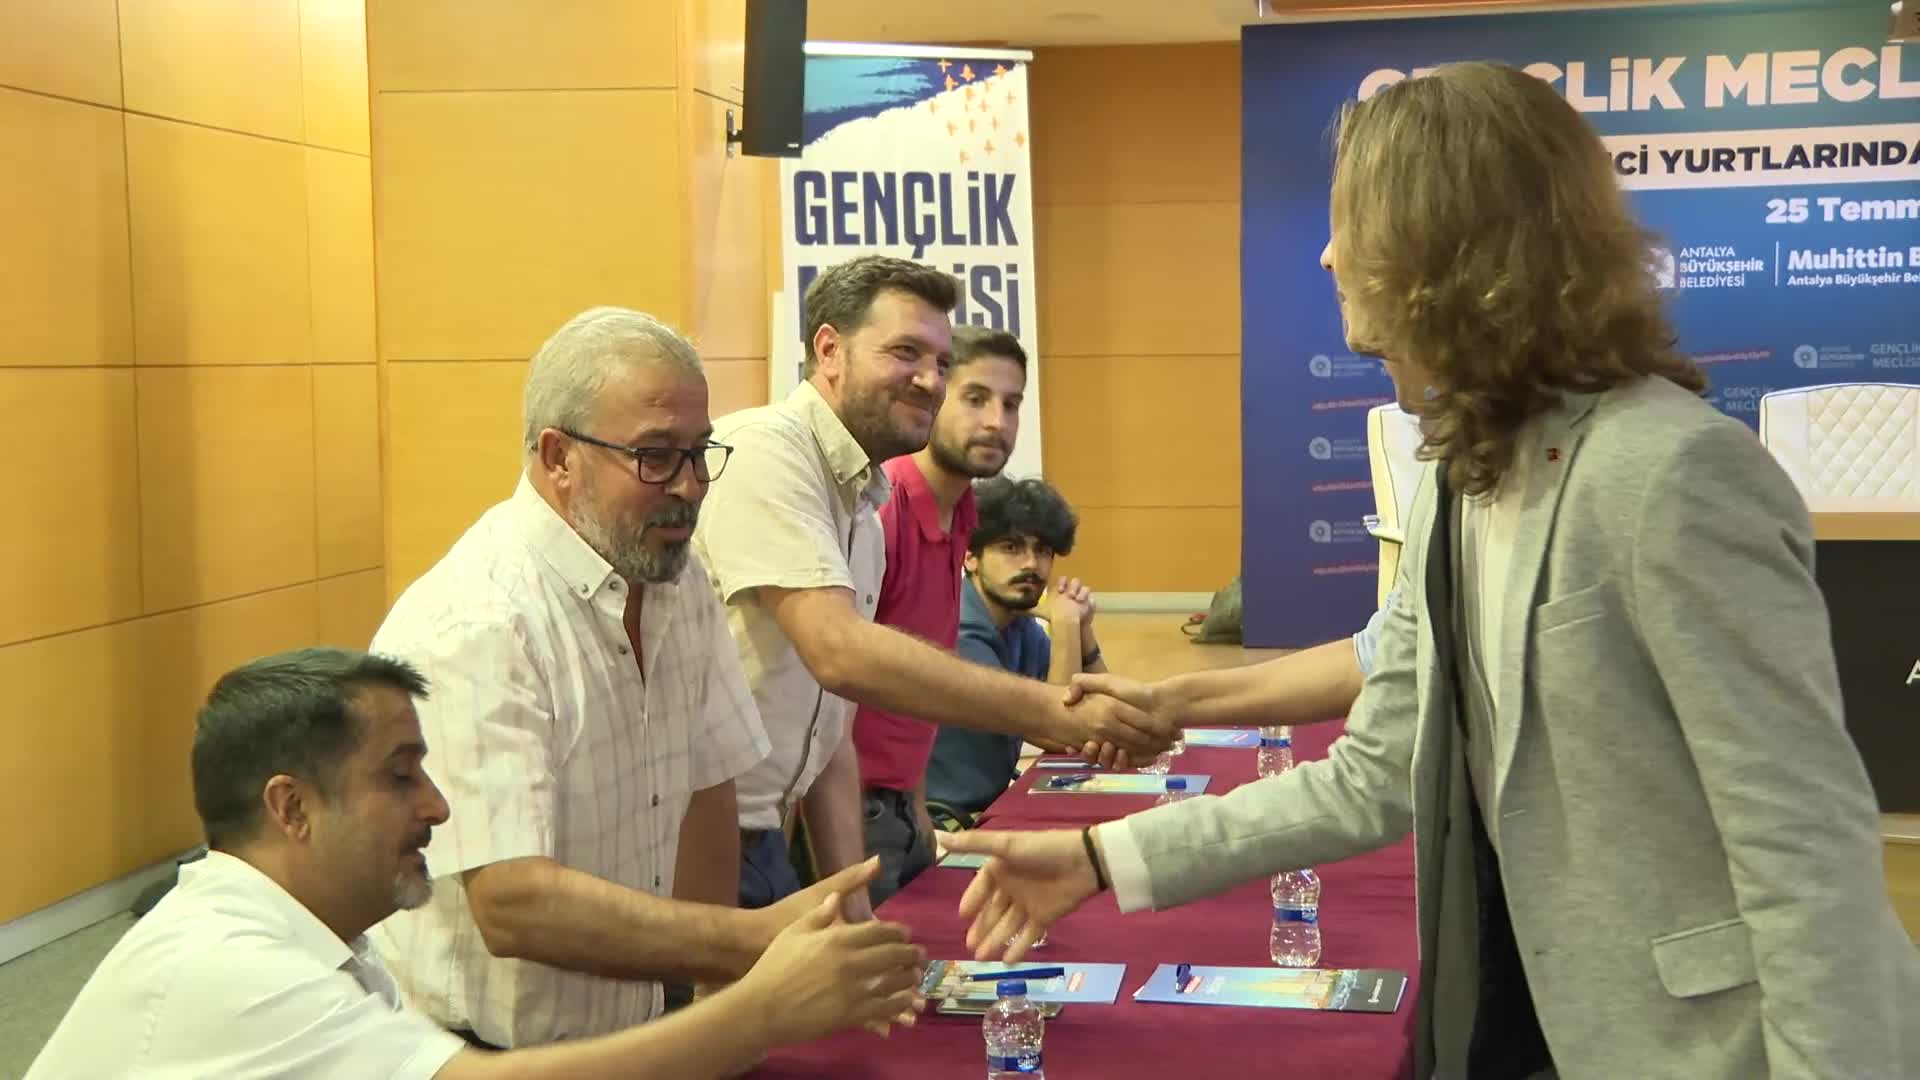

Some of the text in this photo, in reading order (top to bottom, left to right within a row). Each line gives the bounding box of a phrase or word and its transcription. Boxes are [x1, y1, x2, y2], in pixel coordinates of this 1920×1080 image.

[794, 170, 1019, 259] GENÇLİK
[1765, 198, 1809, 225] 25
[1680, 246, 1736, 259] ANTALYA
[1787, 246, 1904, 271] Muhittin
[1680, 257, 1765, 274] BÜYÜKŞEHİR
[1680, 273, 1745, 289] BELEDİYESİ
[1787, 274, 1834, 288] Antalya
[1835, 272, 1902, 287] Büyükşehir
